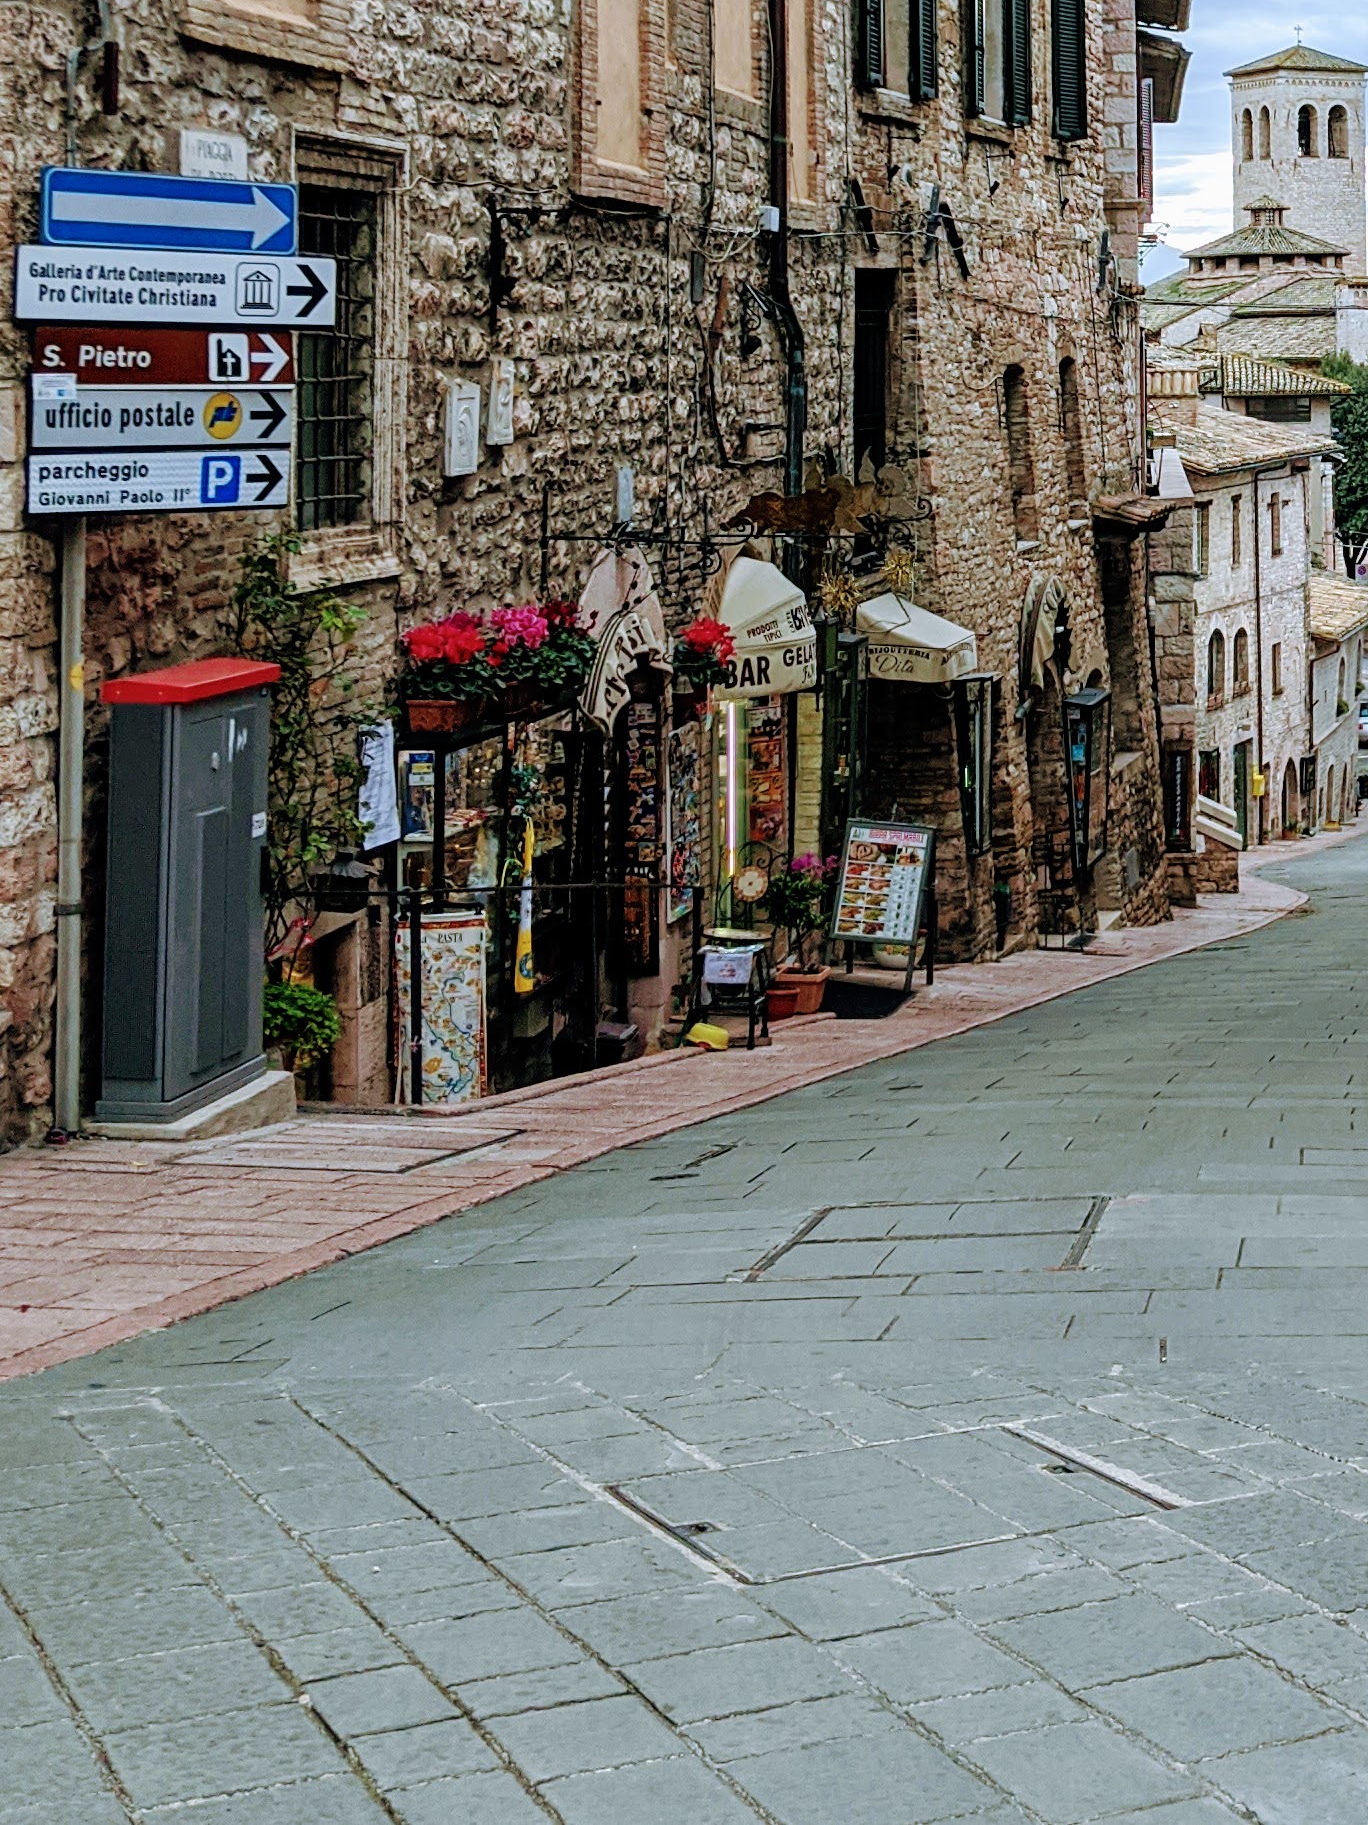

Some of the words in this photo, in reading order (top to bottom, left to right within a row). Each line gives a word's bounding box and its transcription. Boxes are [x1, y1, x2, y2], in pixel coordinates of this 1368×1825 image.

[29, 262, 82, 280] Galleria
[86, 265, 126, 281] d'Arte
[129, 266, 226, 286] Contemporanea
[38, 284, 66, 303] Pro
[71, 285, 134, 304] Civitate
[138, 287, 217, 307] Christiana
[42, 344, 66, 367] S.
[78, 344, 151, 368] Pietro
[45, 402, 112, 429] ufficio
[119, 401, 195, 434] postale
[38, 461, 149, 483] parcheggio
[207, 460, 233, 499] P
[38, 490, 109, 506] Giovanni
[120, 489, 164, 504] Paolo
[746, 620, 779, 639] PRODOTTI
[763, 630, 783, 643] TIPICI
[725, 656, 771, 689] BAR
[437, 932, 463, 943] PASTA
